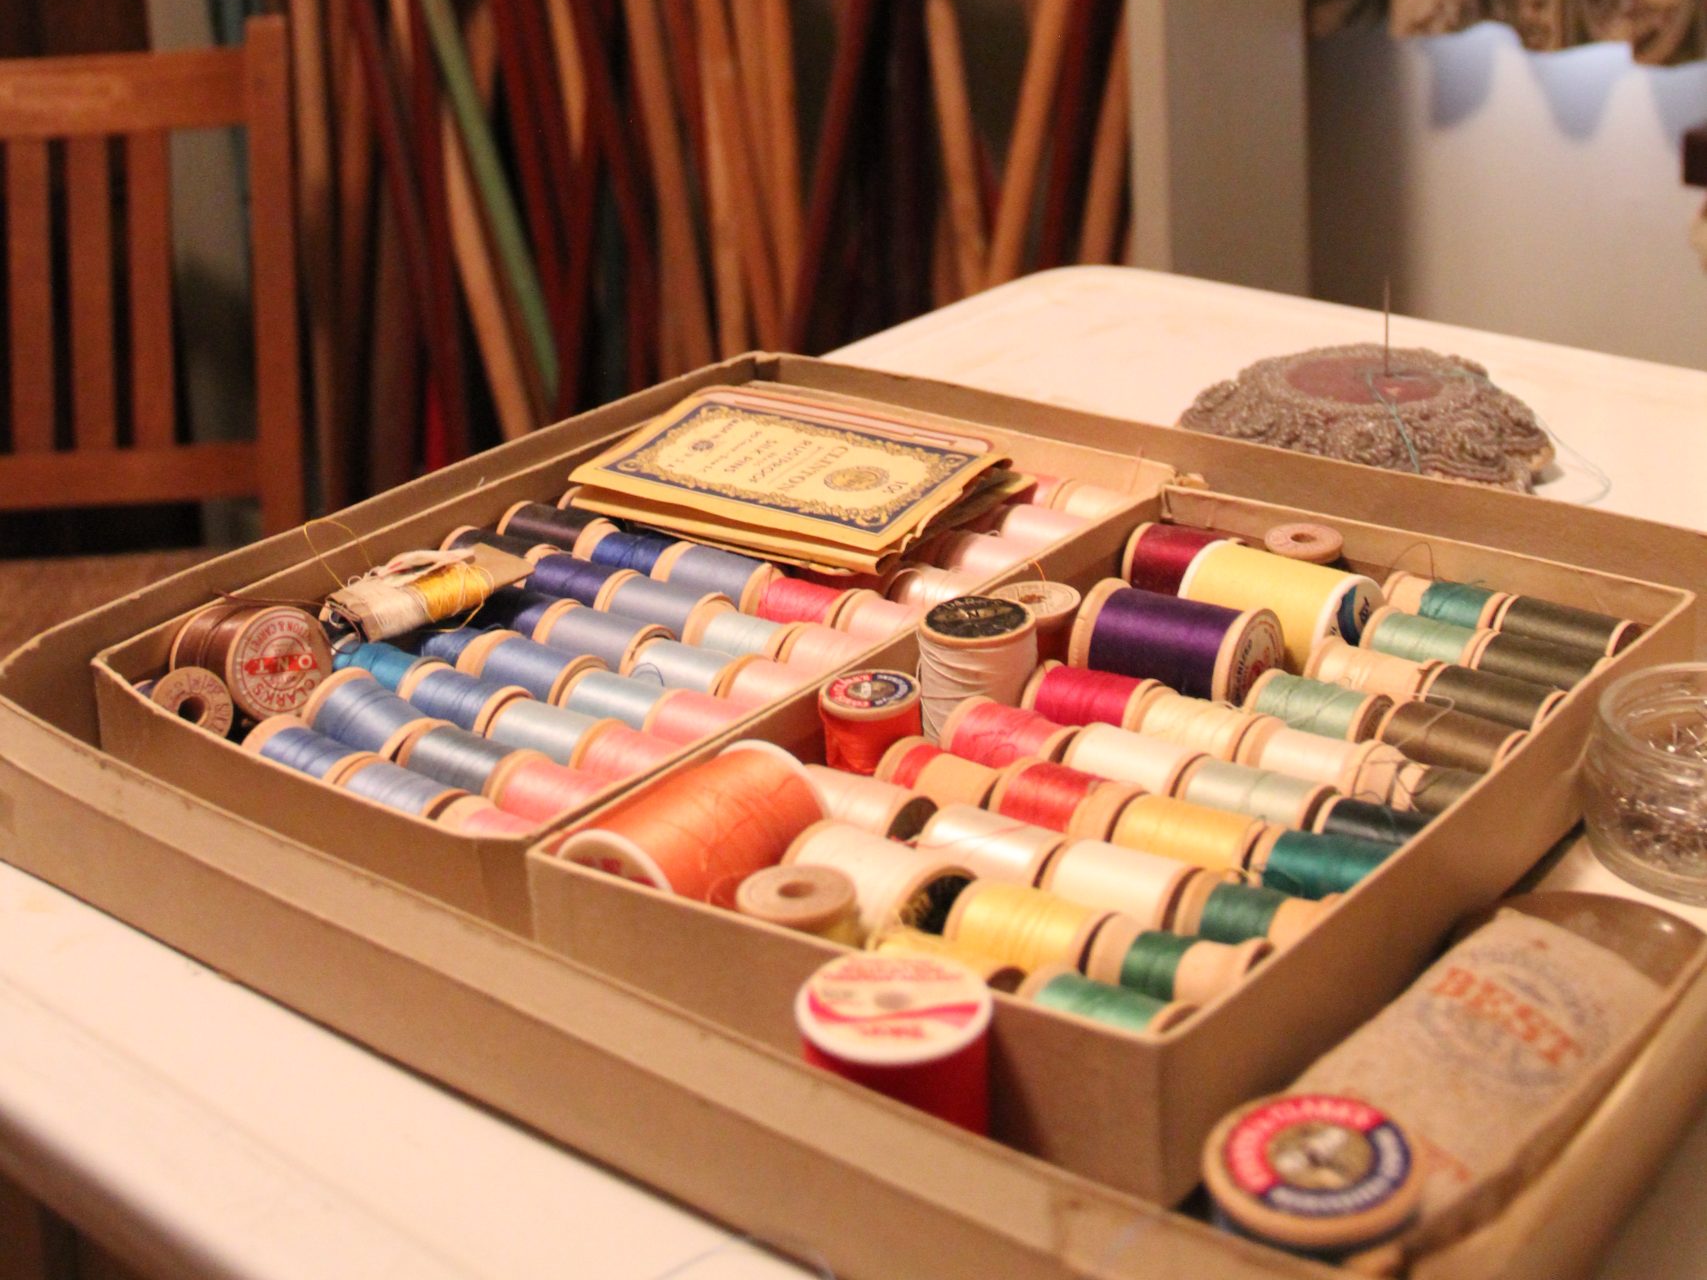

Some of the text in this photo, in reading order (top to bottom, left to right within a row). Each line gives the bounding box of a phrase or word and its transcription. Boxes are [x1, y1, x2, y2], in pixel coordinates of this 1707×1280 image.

[775, 445, 850, 493] CLINTON
[250, 623, 277, 652] CARPET
[277, 622, 285, 633] &
[1431, 966, 1585, 1065] BEST
